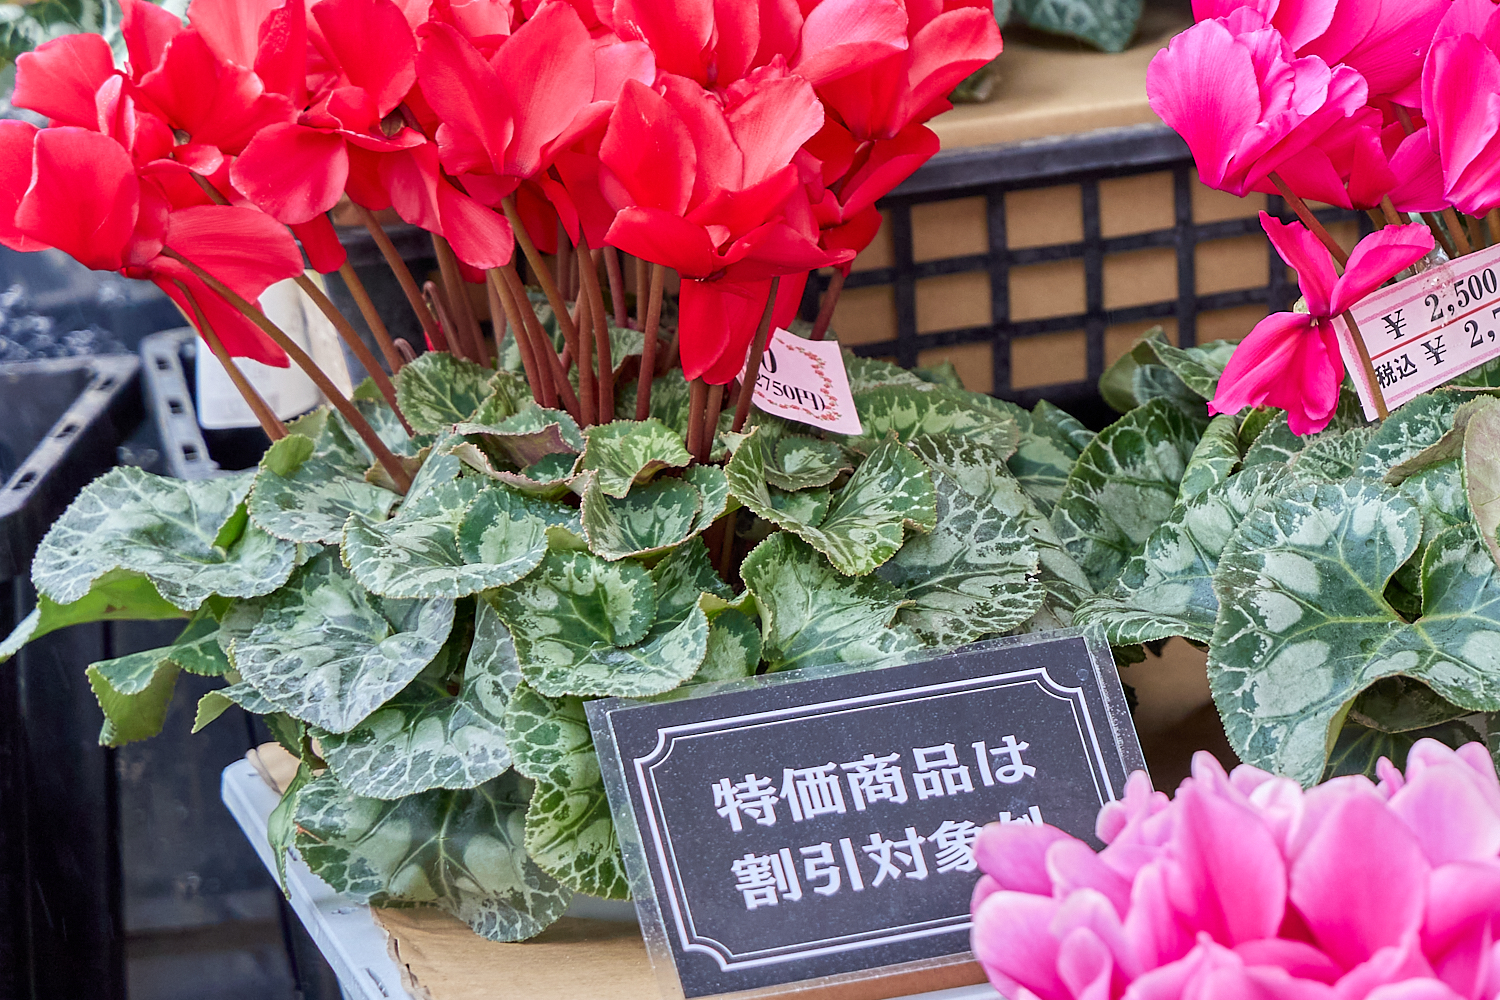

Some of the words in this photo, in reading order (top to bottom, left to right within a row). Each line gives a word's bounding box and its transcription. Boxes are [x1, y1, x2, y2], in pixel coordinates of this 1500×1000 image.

[1424, 267, 1499, 323] 2,500
[710, 734, 1038, 833] 特価商品は
[730, 805, 1045, 910] 割引対象
